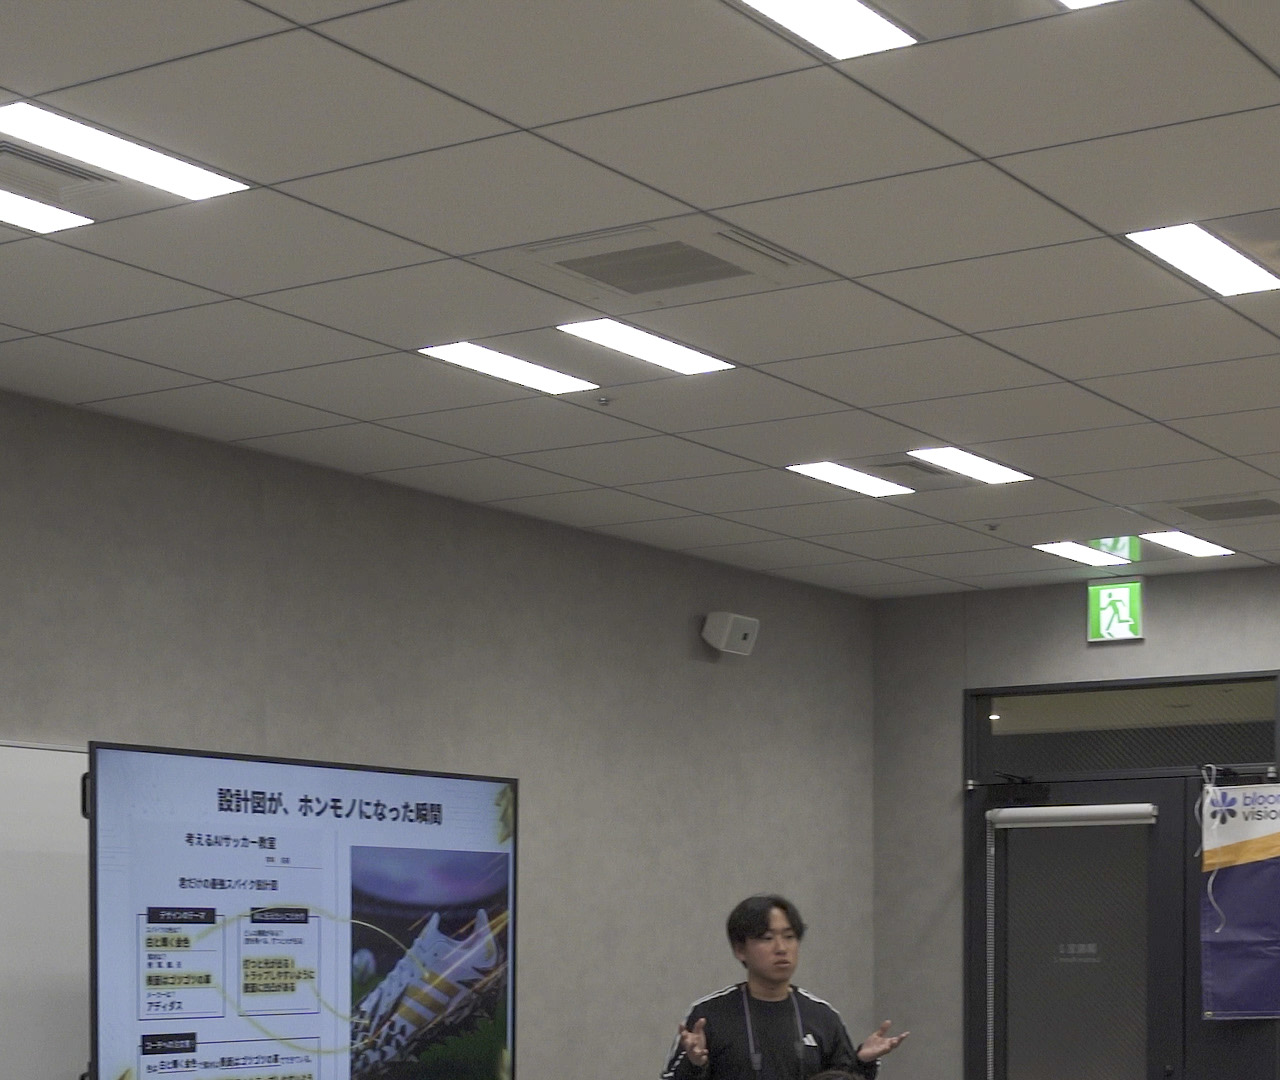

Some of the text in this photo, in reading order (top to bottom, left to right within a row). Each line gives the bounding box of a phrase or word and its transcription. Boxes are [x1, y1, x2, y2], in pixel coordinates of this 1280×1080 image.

[217, 788, 444, 825] 設計図が、ホンモノになった瞬間
